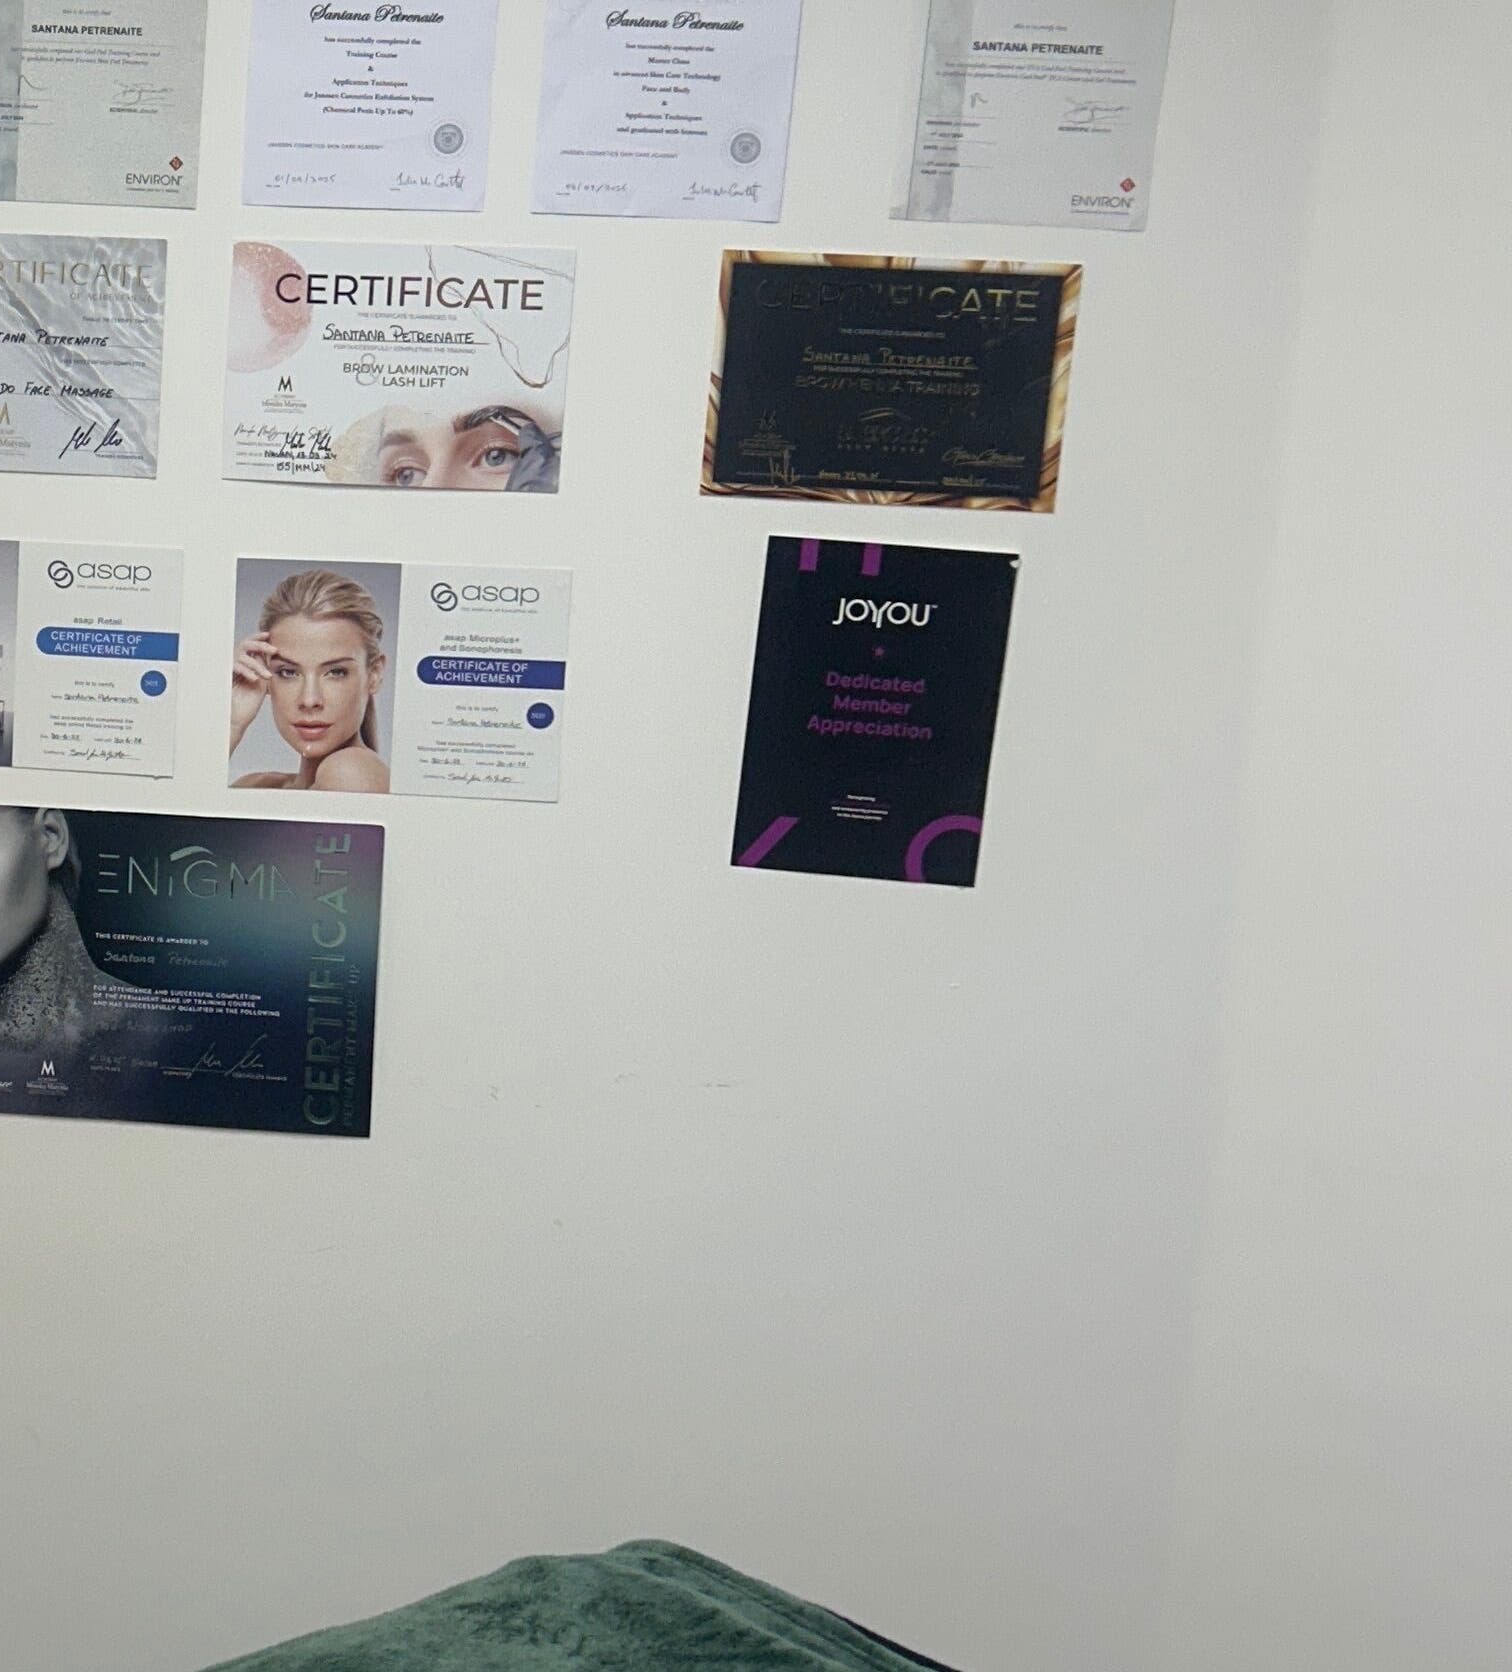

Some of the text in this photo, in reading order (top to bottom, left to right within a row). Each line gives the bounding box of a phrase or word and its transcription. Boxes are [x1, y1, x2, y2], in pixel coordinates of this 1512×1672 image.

[309, 3, 445, 24] Santana Petrenaite
[605, 9, 745, 32] Santana Petrenaite
[31, 24, 143, 37] SANTANA PETRENAITE
[346, 50, 374, 59] Training
[972, 41, 1104, 55] SANTANA PETRENAITE
[332, 78, 408, 88] Application Techniques
[275, 272, 545, 311] CERTIFICATE
[343, 362, 470, 377] BROW LAMINATION
[277, 375, 293, 393] M
[382, 376, 447, 388] LASH LIFT
[77, 562, 152, 585] asap
[461, 584, 540, 606] asap
[97, 617, 123, 625] Retail
[50, 630, 143, 645] CERTIFICATE OF
[53, 642, 137, 656] ACHIEVEMENT
[431, 659, 528, 673] CERTIFICATE OF
[435, 671, 523, 684] ACHIEVEMENT
[825, 670, 927, 694] Dedicated
[833, 695, 912, 717] Member
[807, 715, 933, 740] Appreciation
[95, 932, 112, 940] THIS
[113, 933, 155, 943] CERTIFICATE
[166, 937, 199, 945] AWARDED
[303, 833, 351, 1126] CERTIFICATE
[109, 985, 152, 995] ATTENDANCE
[154, 987, 169, 996] AND
[170, 989, 213, 999] SUCCESSFUL
[216, 991, 262, 1001] COMPLETION
[124, 1002, 177, 1012] SUCCESSFULLY
[178, 1004, 214, 1014] QUALIFIED
[225, 1007, 238, 1015] THE
[240, 1008, 281, 1018] FOLLOWING
[194, 998, 226, 1008] TRAINING
[227, 1000, 256, 1009] COURSE
[40, 1060, 56, 1076] M
